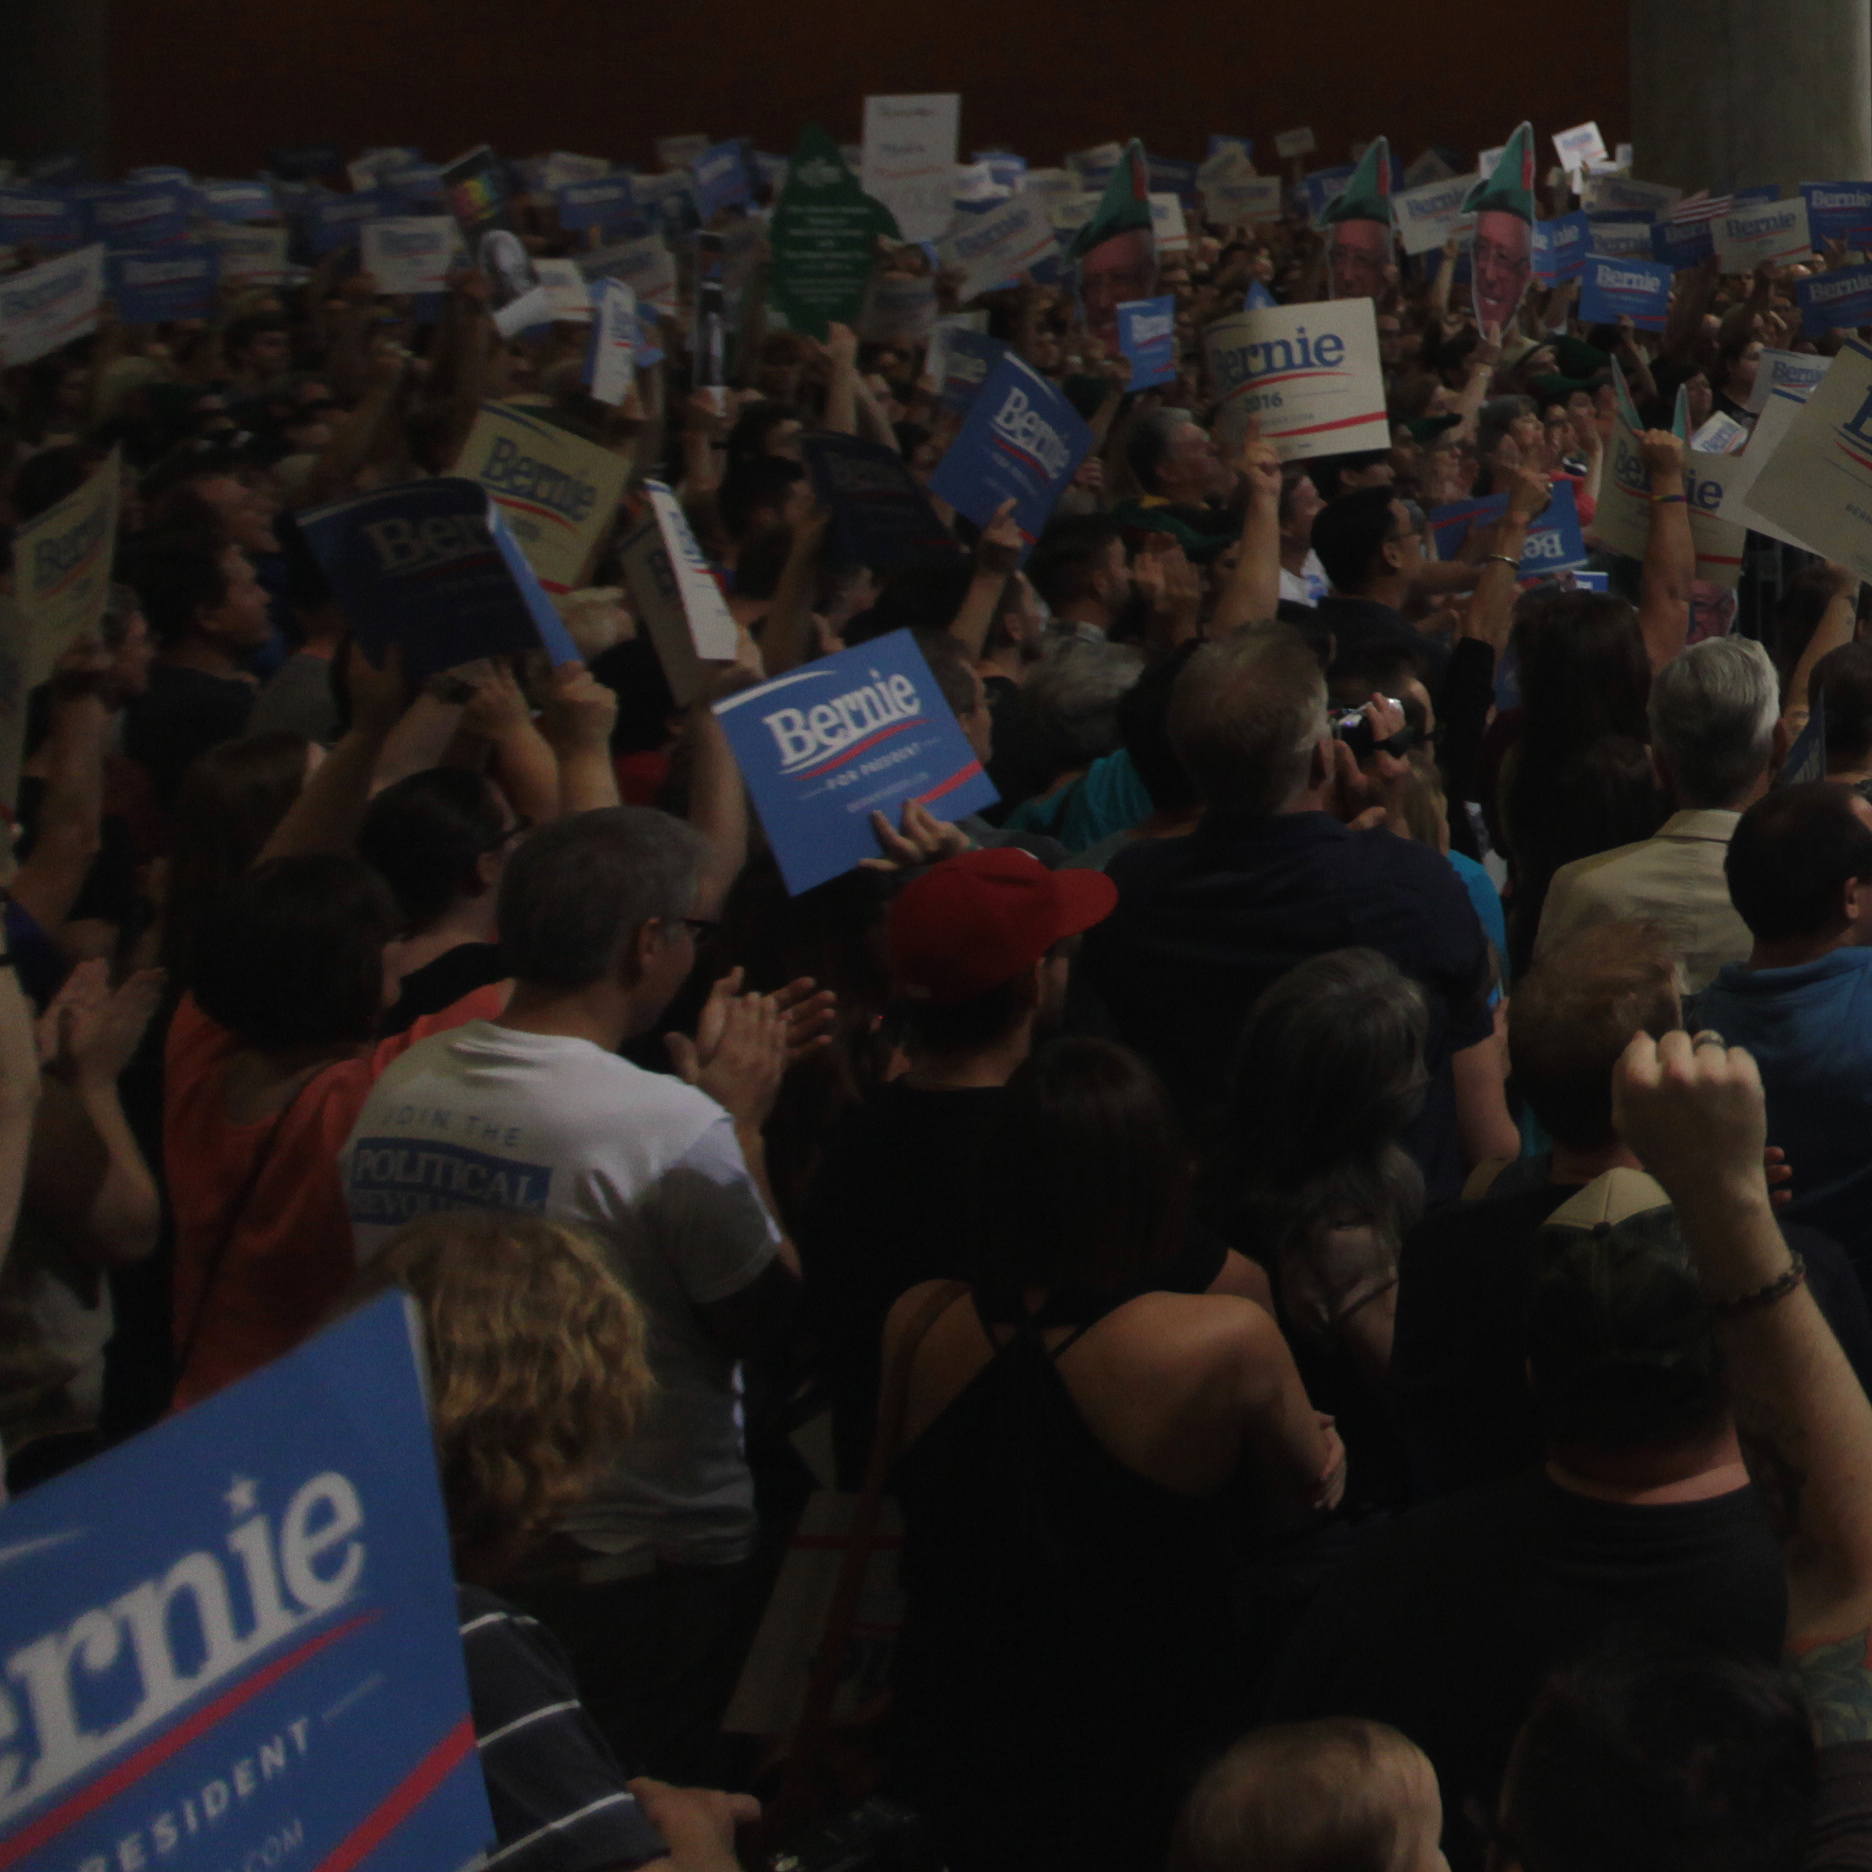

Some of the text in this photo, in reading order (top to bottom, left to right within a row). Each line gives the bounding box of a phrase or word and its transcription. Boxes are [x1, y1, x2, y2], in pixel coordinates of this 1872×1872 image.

[1726, 211, 1798, 239] Bernie
[1811, 189, 1872, 209] Bernie
[1597, 264, 1662, 293] Bernie
[996, 386, 1071, 480] Bernie
[481, 435, 596, 523] Bernie
[762, 668, 922, 767] Bernie
